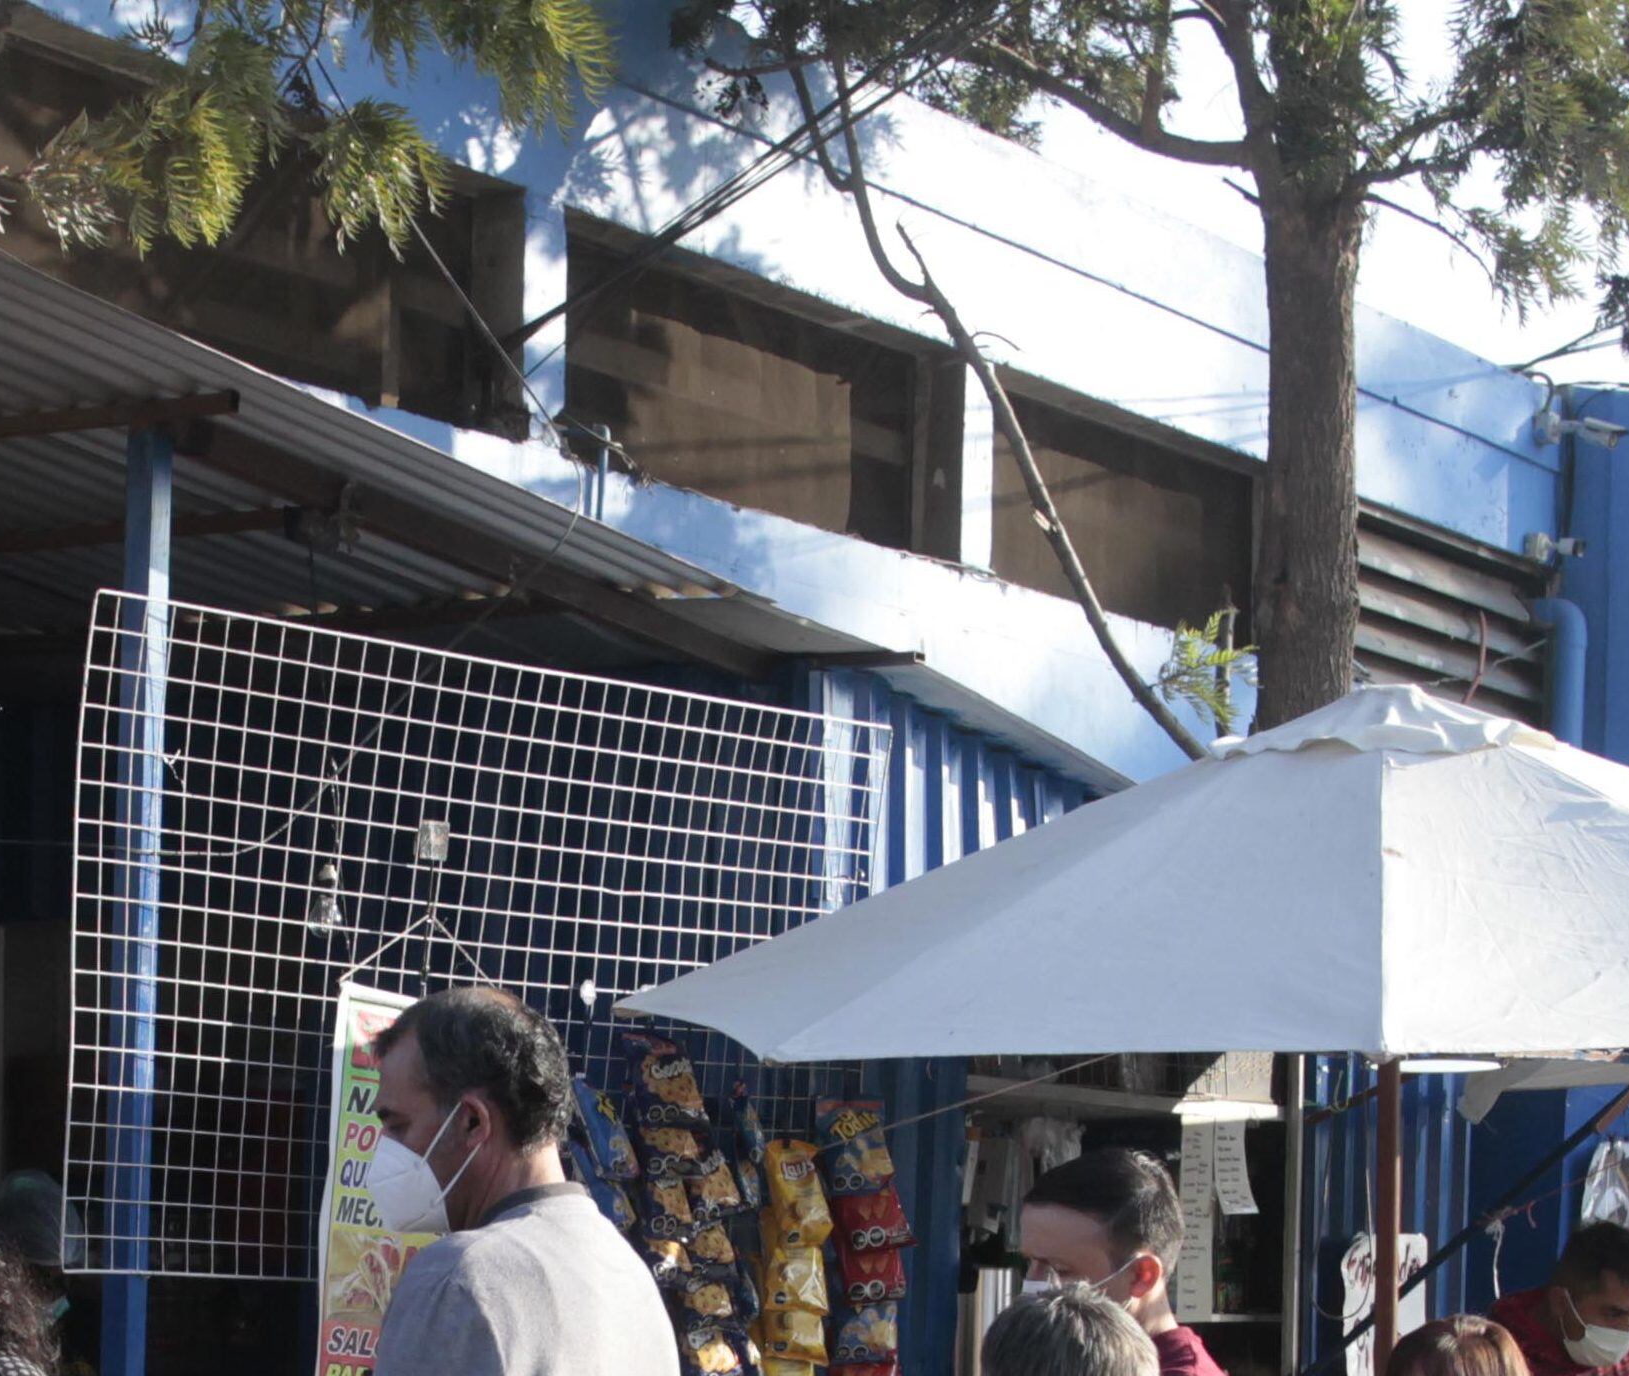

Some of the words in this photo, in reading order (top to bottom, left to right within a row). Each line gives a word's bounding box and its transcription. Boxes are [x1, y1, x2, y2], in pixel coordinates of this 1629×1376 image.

[343, 1122, 380, 1152] PO
[340, 1158, 371, 1190] QU
[335, 1196, 383, 1227] MEC
[328, 1328, 376, 1357] SAL
